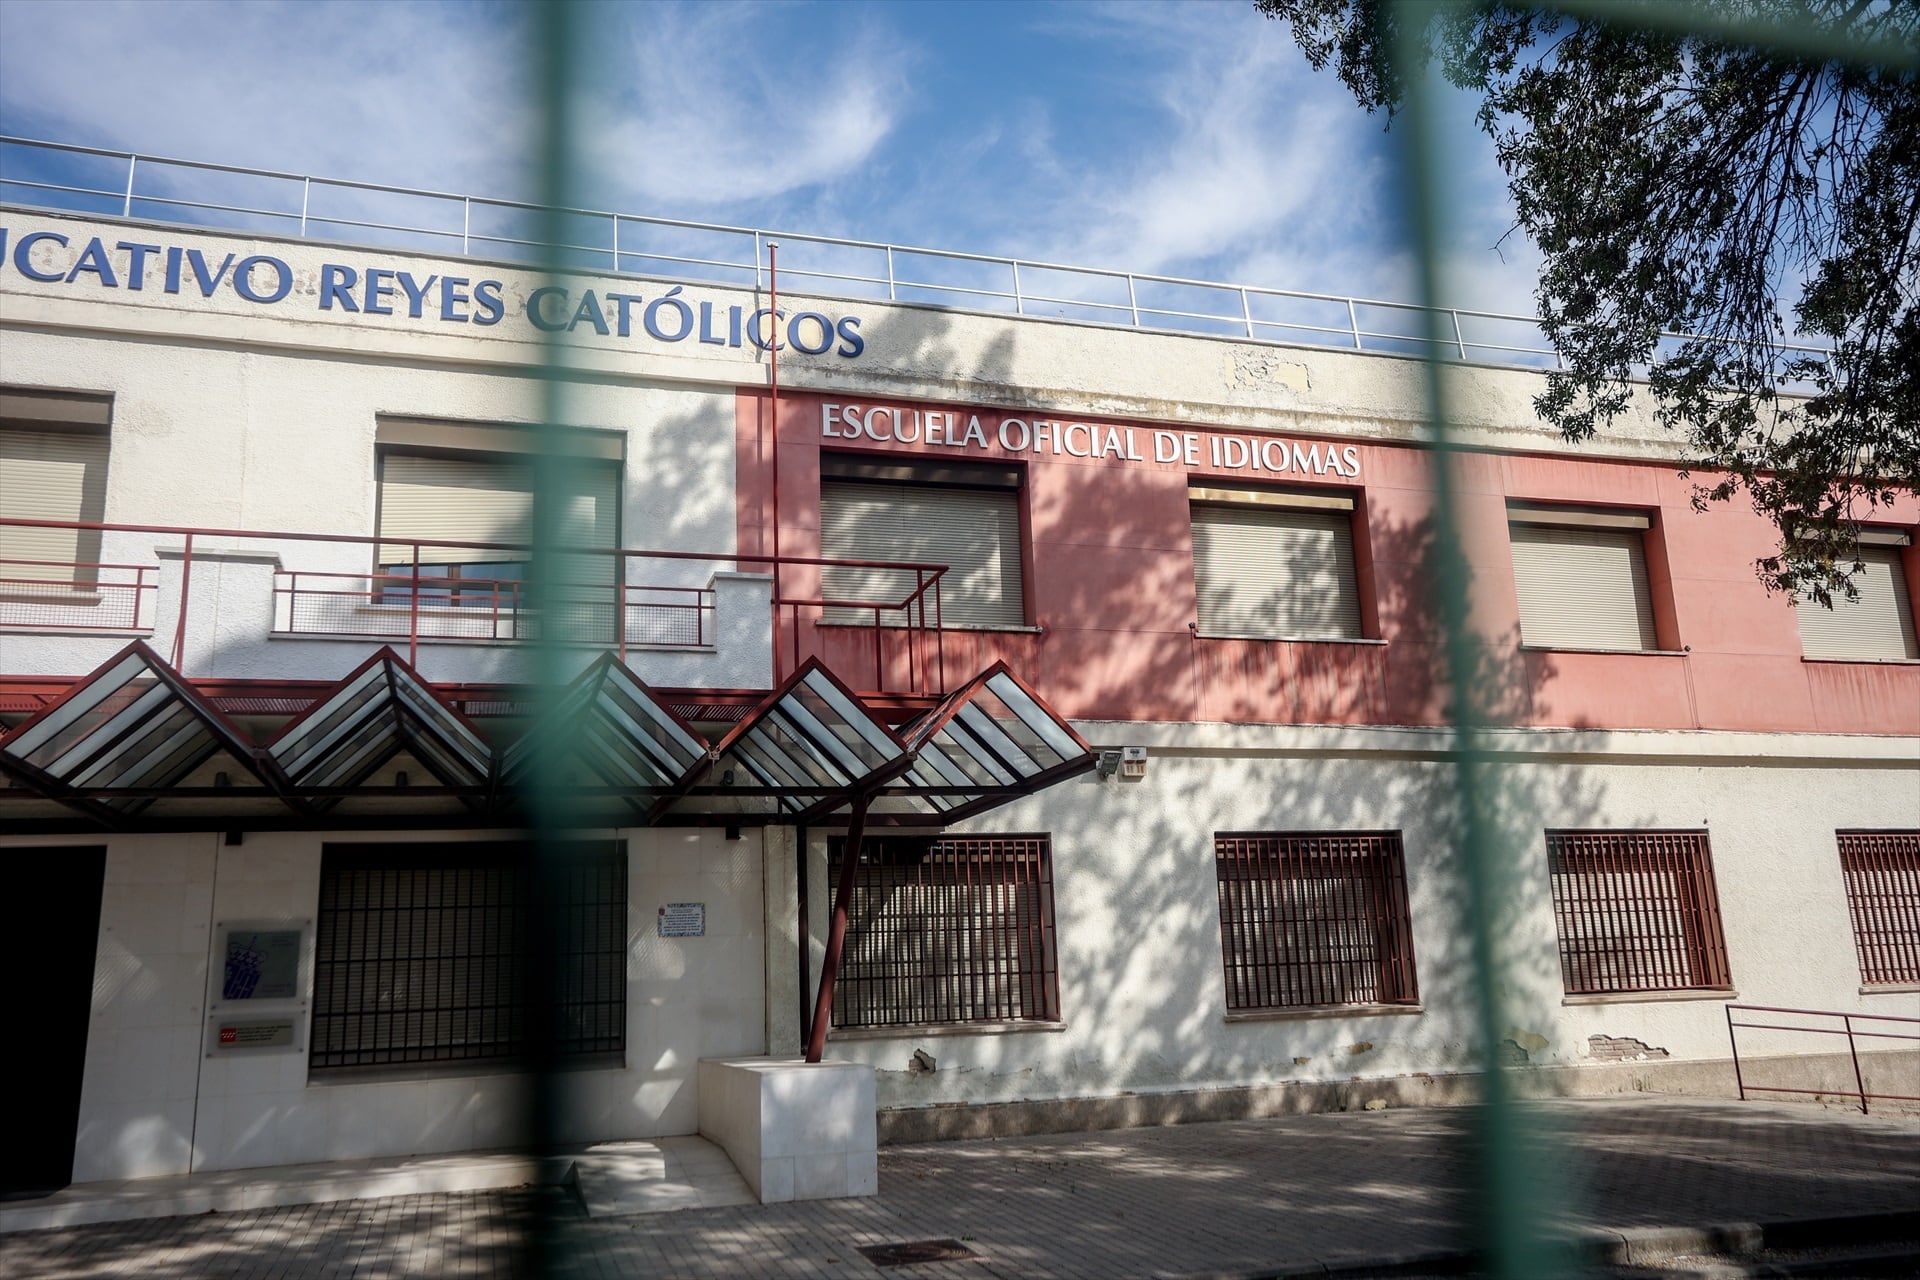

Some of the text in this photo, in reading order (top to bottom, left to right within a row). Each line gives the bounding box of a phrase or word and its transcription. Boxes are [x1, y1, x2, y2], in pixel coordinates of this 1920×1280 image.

[319, 263, 504, 325] REYES
[526, 285, 865, 358] CATÓLICOS
[821, 402, 1361, 478] ESCUELA OFICIAL DE IDIOMAS
